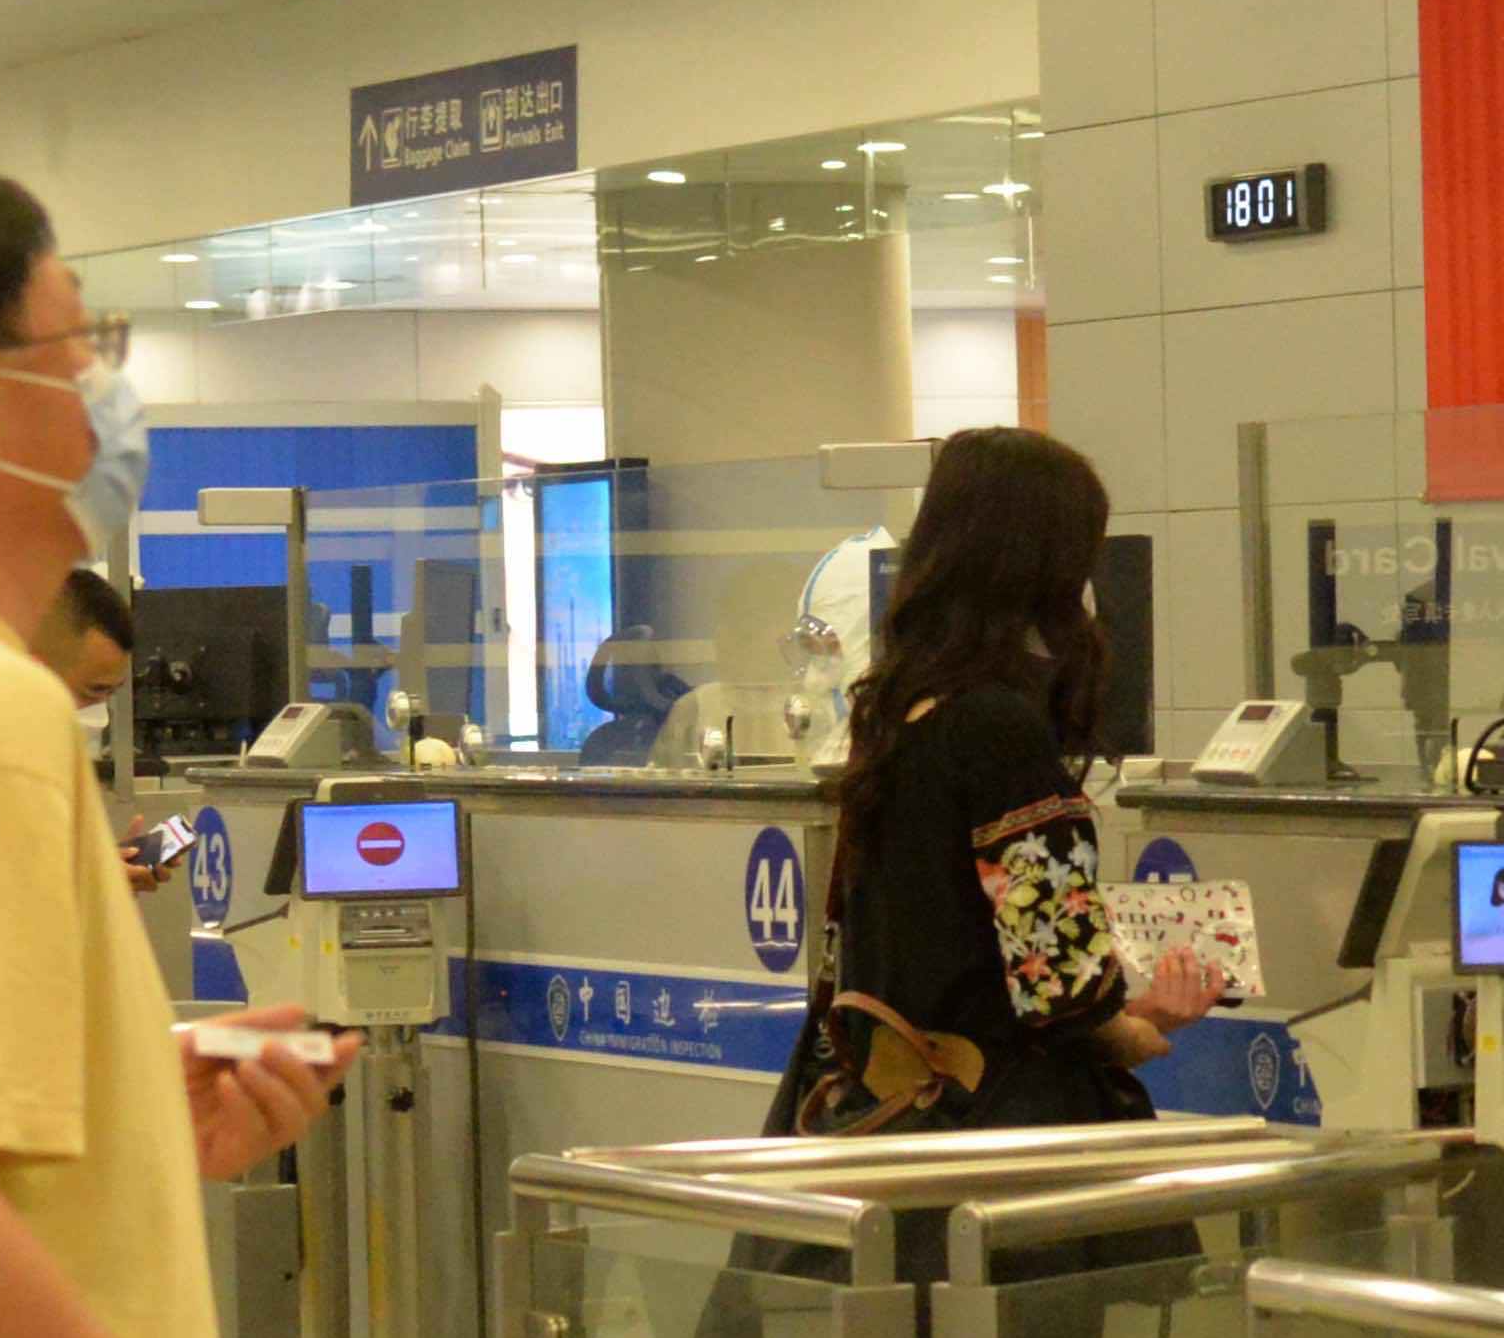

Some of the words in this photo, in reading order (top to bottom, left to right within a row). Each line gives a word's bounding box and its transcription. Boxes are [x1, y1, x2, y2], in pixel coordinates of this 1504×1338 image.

[1226, 178, 1293, 227] 1801
[193, 832, 227, 902] 43
[749, 859, 799, 943] 44
